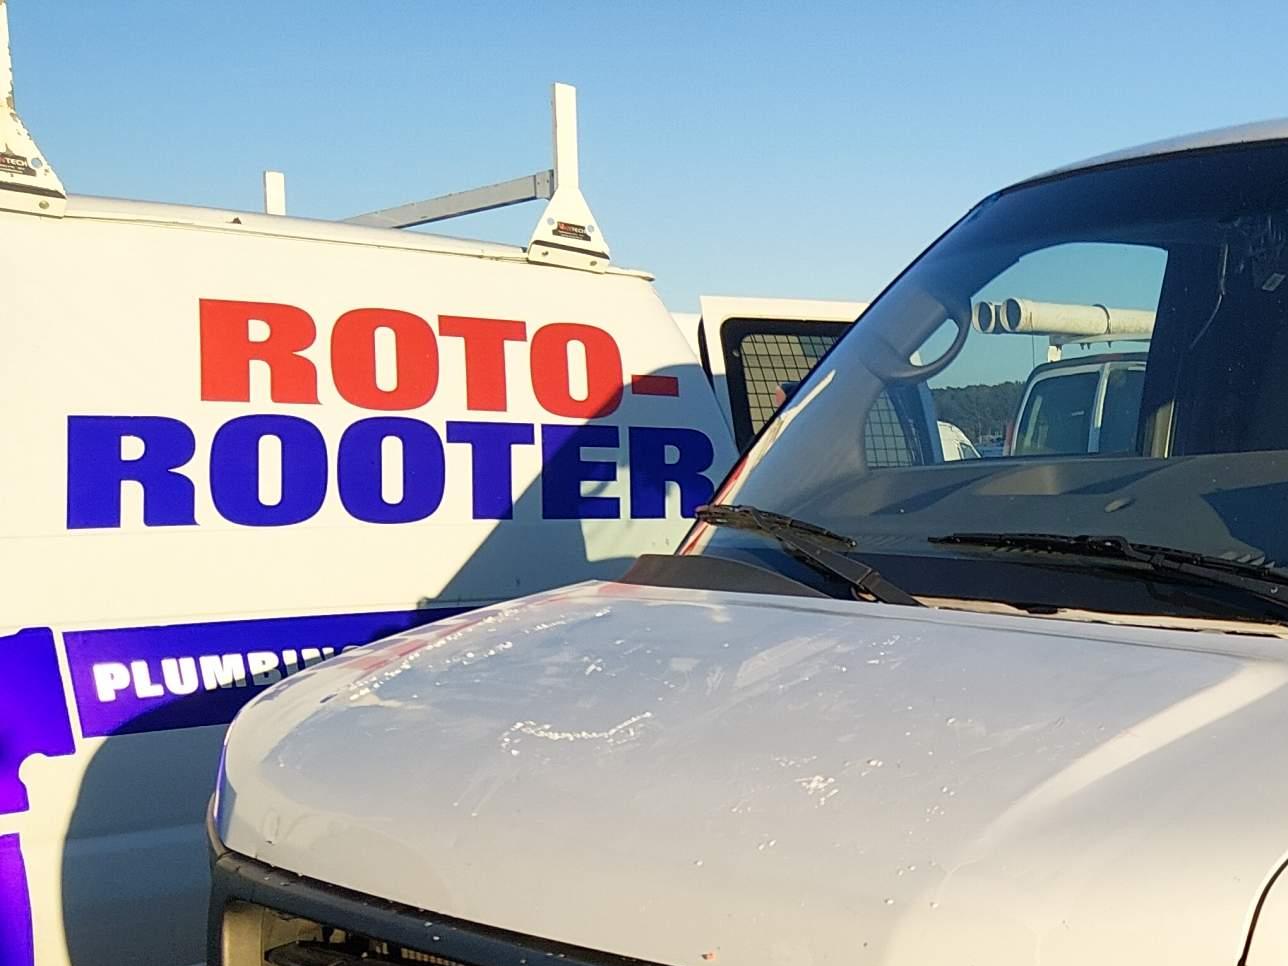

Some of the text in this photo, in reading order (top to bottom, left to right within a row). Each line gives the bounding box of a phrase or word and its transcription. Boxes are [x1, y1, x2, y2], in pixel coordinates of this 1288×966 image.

[199, 298, 679, 419] ROTO-
[67, 414, 715, 529] ROOTER
[92, 645, 360, 703] PLUMBI
